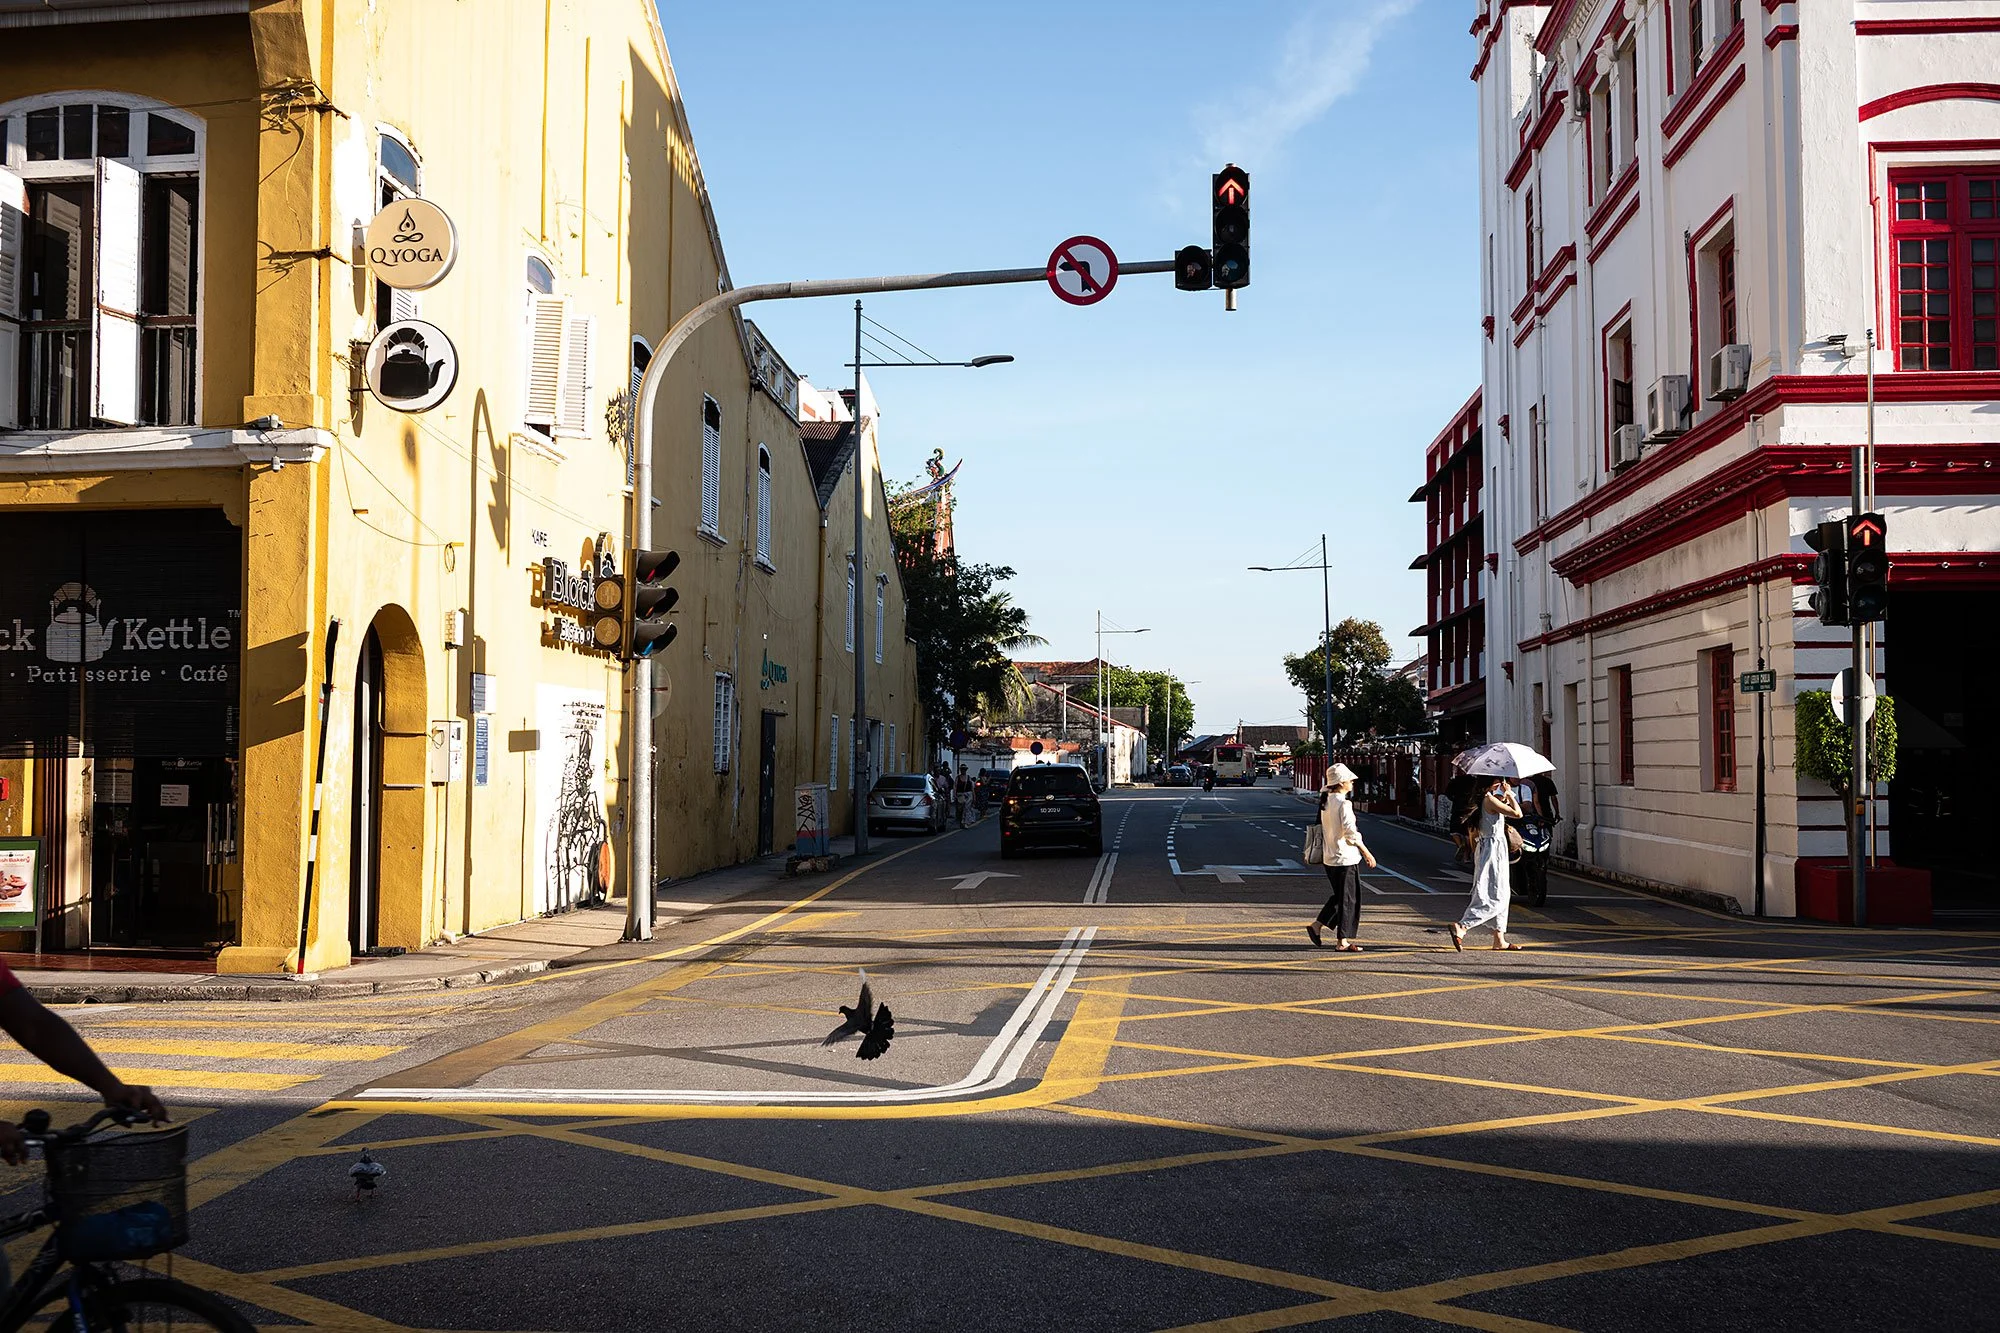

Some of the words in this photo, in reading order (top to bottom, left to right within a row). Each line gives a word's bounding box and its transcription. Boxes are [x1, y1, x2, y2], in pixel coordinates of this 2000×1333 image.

[371, 247, 398, 267] Q
[390, 248, 443, 263] YOGA
[122, 618, 231, 650] Kettle
[27, 665, 151, 683] Patisserie
[180, 664, 228, 682] Café
